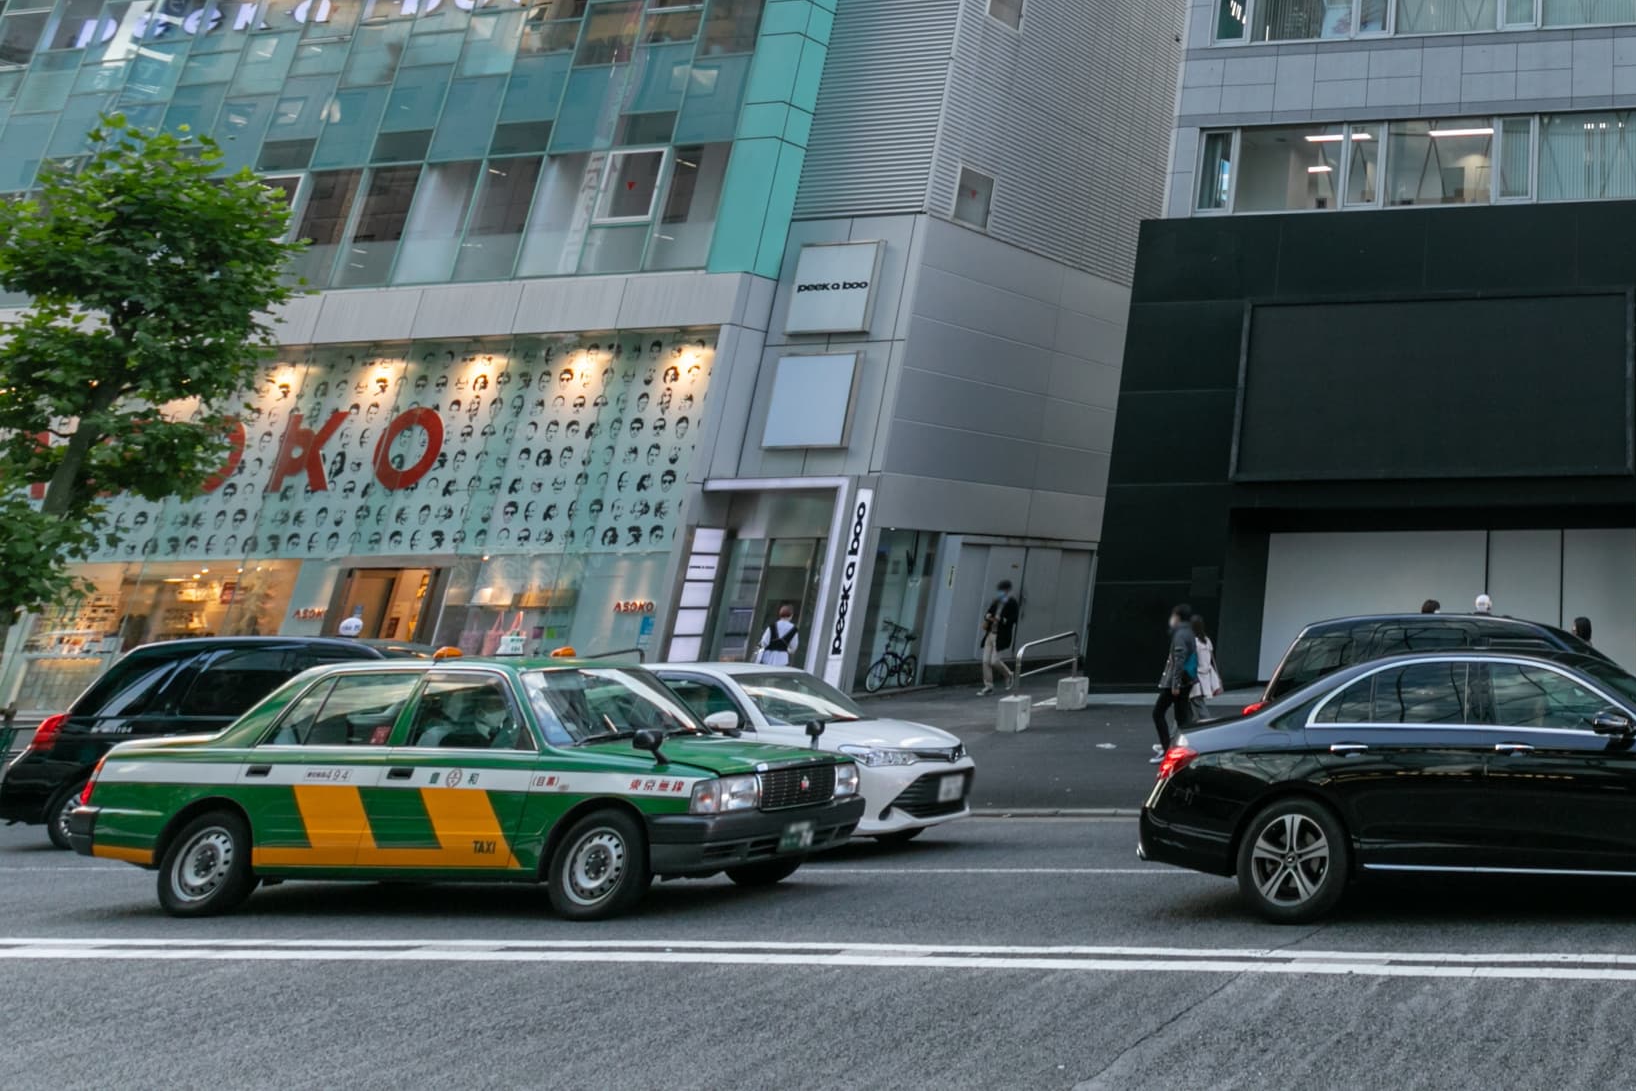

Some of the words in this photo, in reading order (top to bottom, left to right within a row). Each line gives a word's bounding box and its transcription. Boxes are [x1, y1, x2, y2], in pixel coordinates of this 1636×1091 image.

[797, 282, 830, 293] peek
[842, 281, 868, 290] boo
[848, 501, 866, 556] boo
[846, 562, 856, 581] a
[613, 601, 654, 613] ASOKO
[831, 583, 852, 655] peek
[472, 840, 496, 854] TAXI
